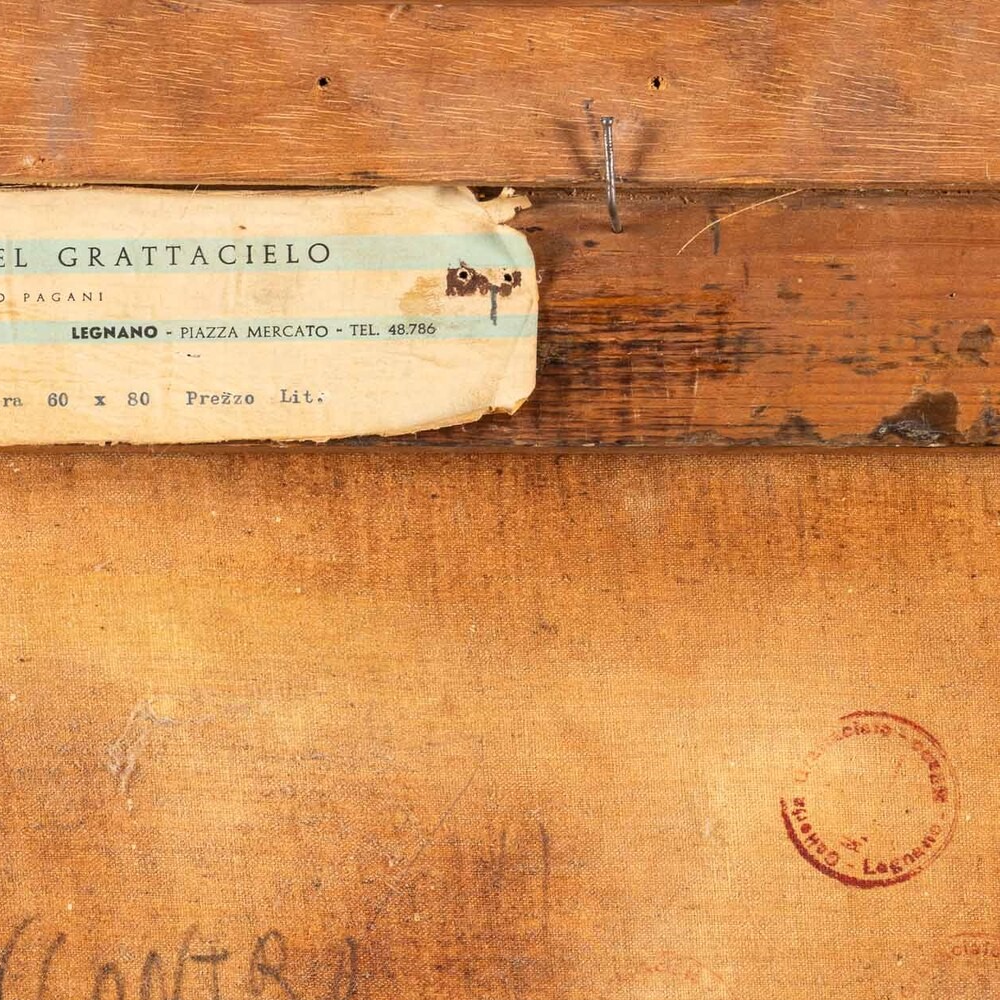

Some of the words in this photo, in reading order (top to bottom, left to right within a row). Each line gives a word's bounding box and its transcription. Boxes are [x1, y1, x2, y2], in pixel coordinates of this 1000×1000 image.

[57, 242, 331, 268] GRATTACIELO
[23, 291, 104, 303] PAGANI
[71, 325, 158, 340] LEGNANO
[180, 326, 239, 339] PIAZZA
[247, 324, 329, 339] MERCATO
[350, 323, 381, 338] TEL.
[387, 322, 437, 337] 48.786
[47, 392, 69, 408] 60
[93, 395, 107, 407] x
[127, 391, 150, 407] 80
[185, 391, 256, 406] Prezzo
